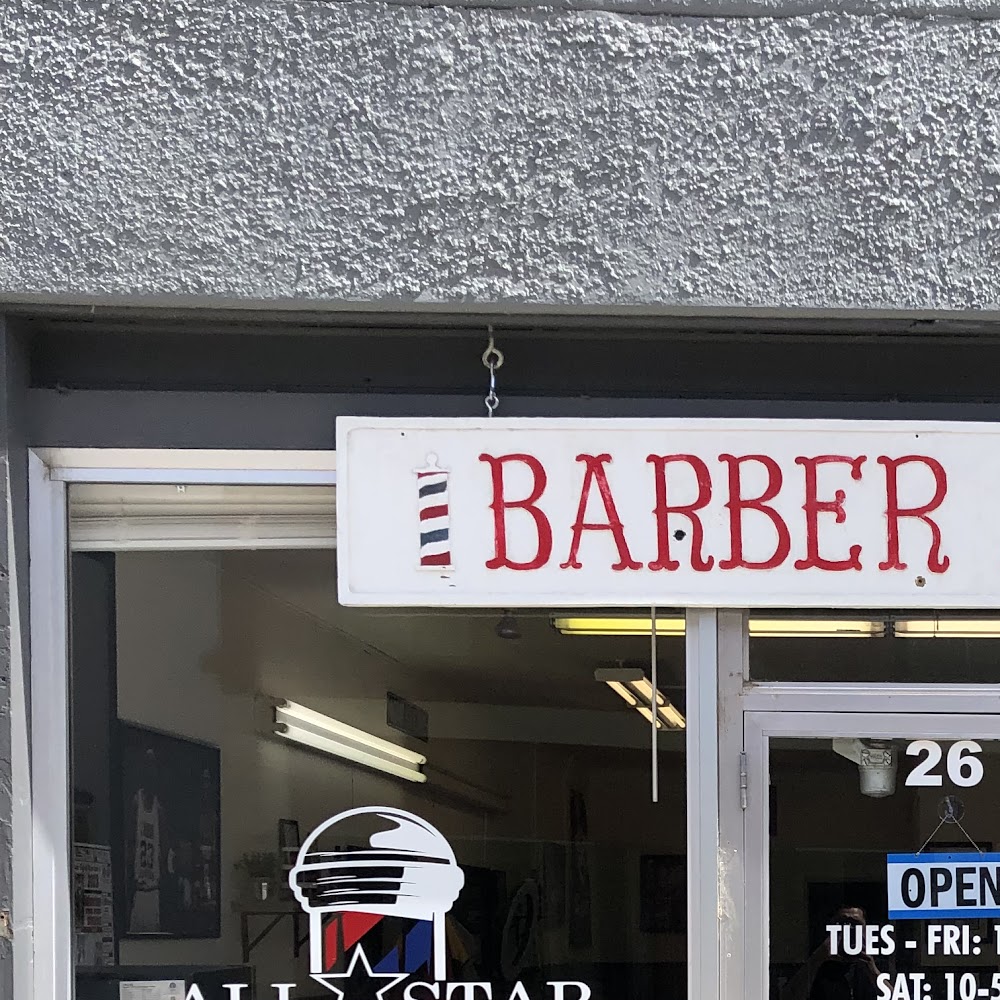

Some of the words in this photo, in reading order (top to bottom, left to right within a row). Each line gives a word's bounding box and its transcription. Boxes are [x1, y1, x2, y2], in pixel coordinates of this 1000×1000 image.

[479, 453, 950, 574] BARBER
[905, 740, 984, 788] 26
[826, 925, 896, 956] TUES
[927, 924, 982, 956] FRI:
